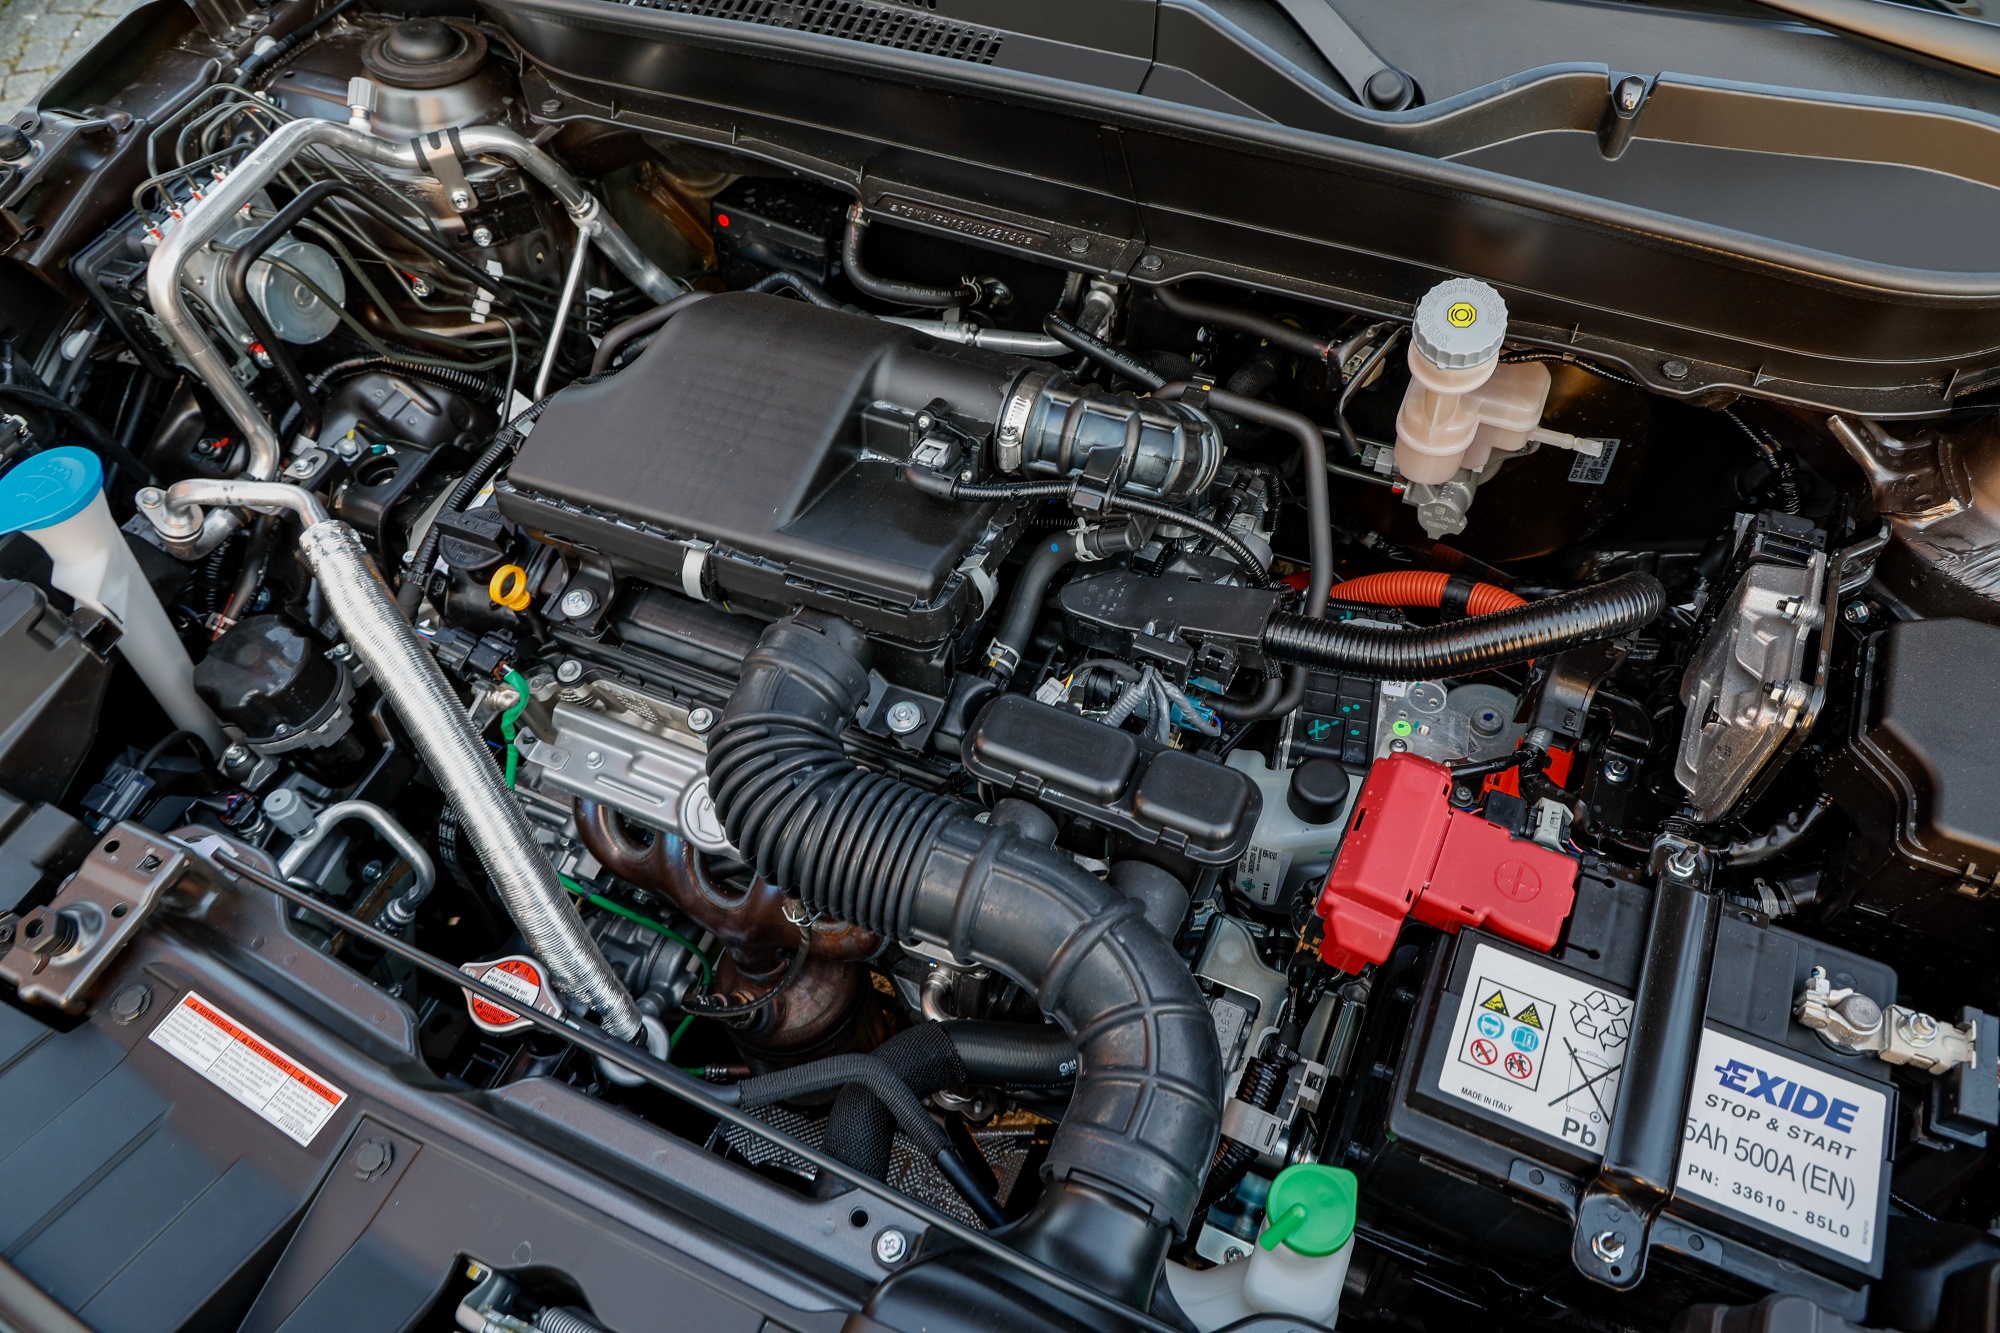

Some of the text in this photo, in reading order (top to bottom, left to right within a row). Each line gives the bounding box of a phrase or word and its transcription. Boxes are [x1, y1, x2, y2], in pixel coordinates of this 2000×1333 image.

[1600, 447, 1614, 468] BOSCH
[451, 541, 481, 556] ENGINE
[199, 1005, 233, 1032] ADVERTENCIA
[249, 1040, 291, 1072] AVERTISSEMENT
[306, 1079, 332, 1099] WARNING
[1461, 1086, 1513, 1113] MADE IN ITALY
[1714, 1058, 1860, 1134] EXIDE
[1561, 1116, 1597, 1147] Pb
[1704, 1093, 1857, 1160] STOP & START
[1734, 1136, 1795, 1182] 500A
[1802, 1162, 1855, 1210] (EN)
[1688, 1163, 1719, 1187] PN:
[1732, 1182, 1785, 1212] 33610
[1805, 1211, 1850, 1239] 85L0
